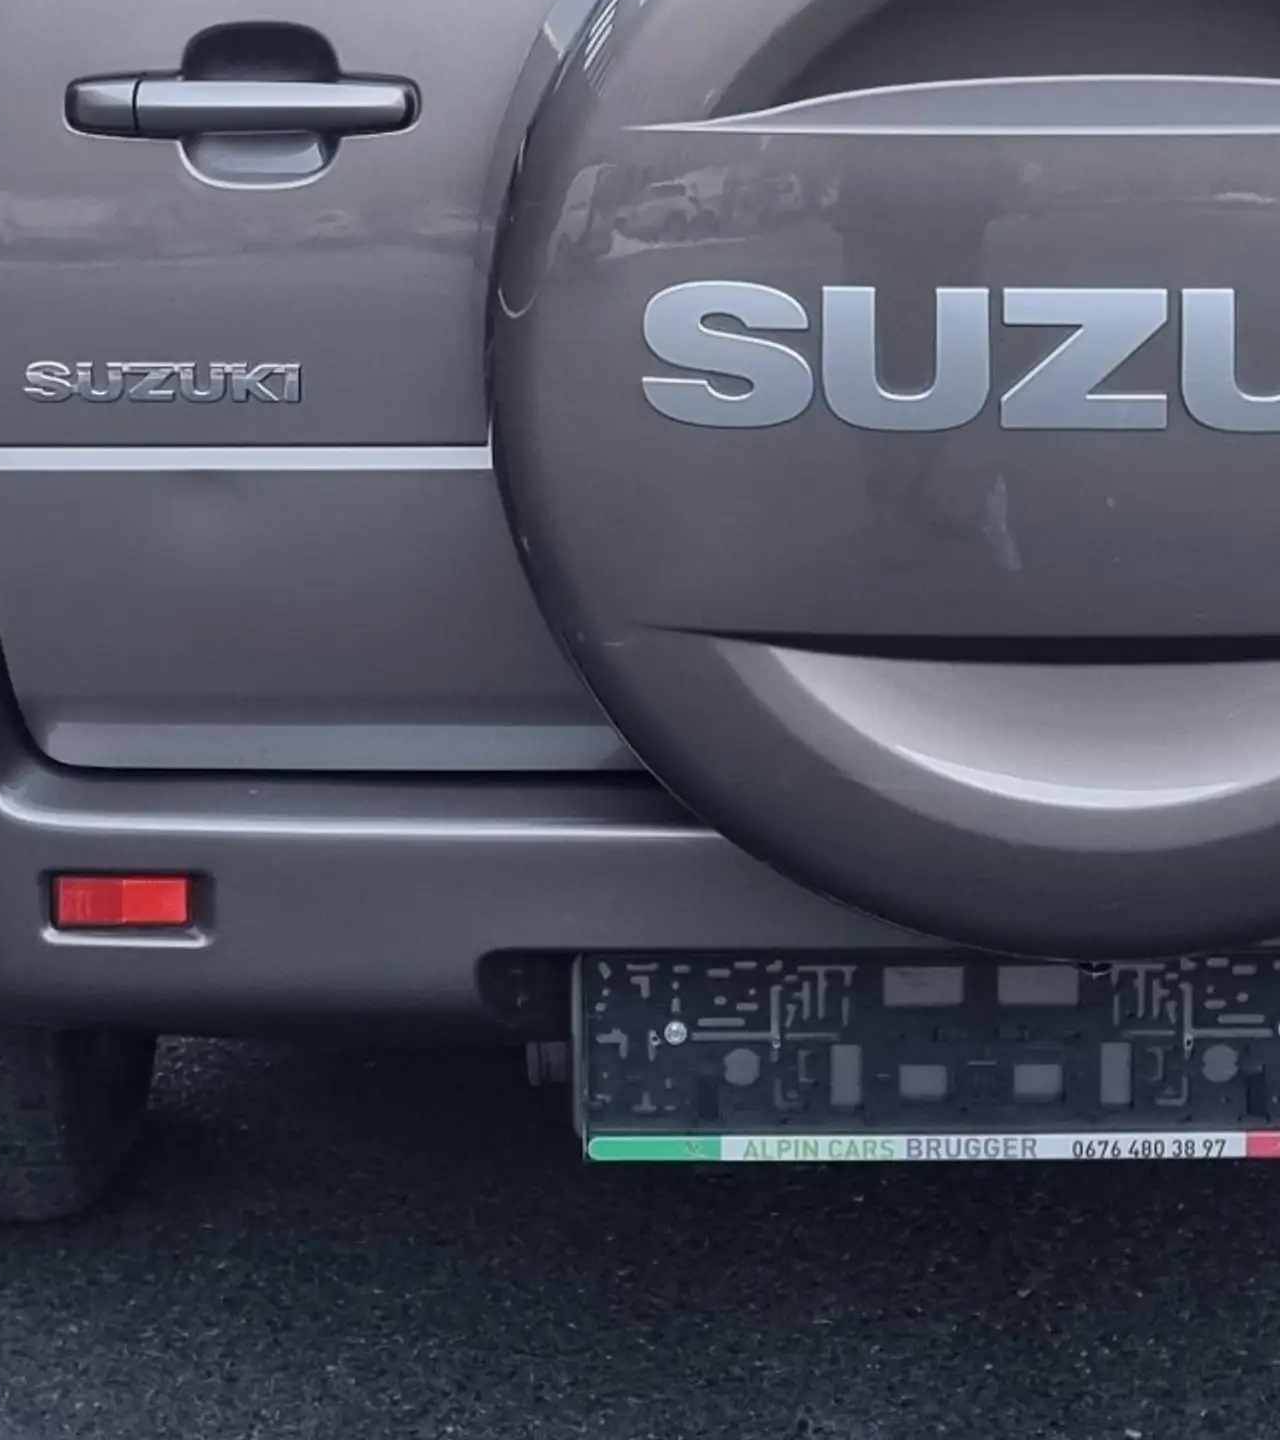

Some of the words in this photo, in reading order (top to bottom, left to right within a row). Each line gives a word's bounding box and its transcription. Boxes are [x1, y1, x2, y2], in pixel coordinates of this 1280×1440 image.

[22, 360, 303, 403] SUZUKI
[742, 1139, 820, 1161] ALPIN
[827, 1139, 895, 1160] CARS
[905, 1137, 1037, 1160] BRUGGER
[1071, 1139, 1121, 1158] 0676
[1128, 1139, 1166, 1158] 480
[1171, 1139, 1196, 1158] 38
[1204, 1138, 1227, 1157] 97
